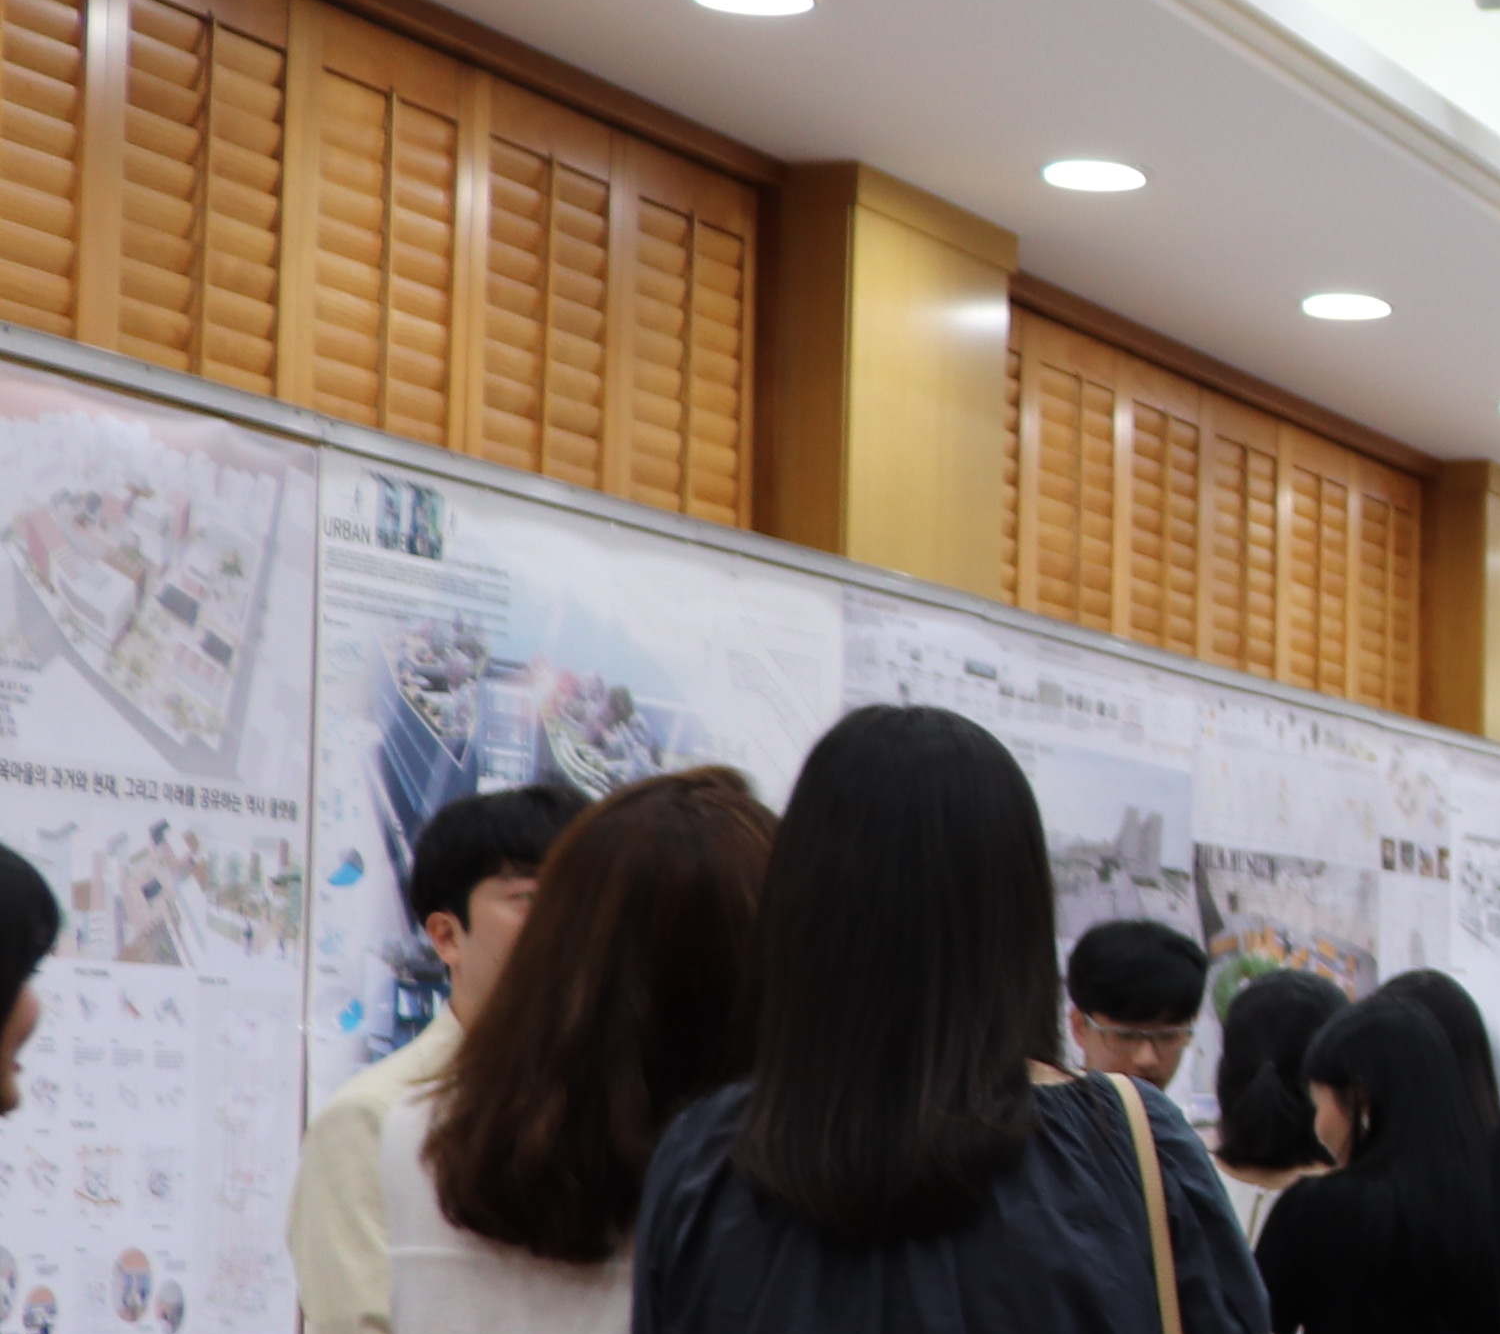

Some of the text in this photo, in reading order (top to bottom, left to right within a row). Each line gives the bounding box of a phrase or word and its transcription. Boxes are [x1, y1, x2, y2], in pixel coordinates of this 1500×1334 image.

[323, 515, 371, 546] URBAN
[51, 766, 88, 793] 과거와
[124, 777, 158, 800] 그리고
[163, 782, 195, 807] 미래를
[200, 787, 241, 814] 공유하는
